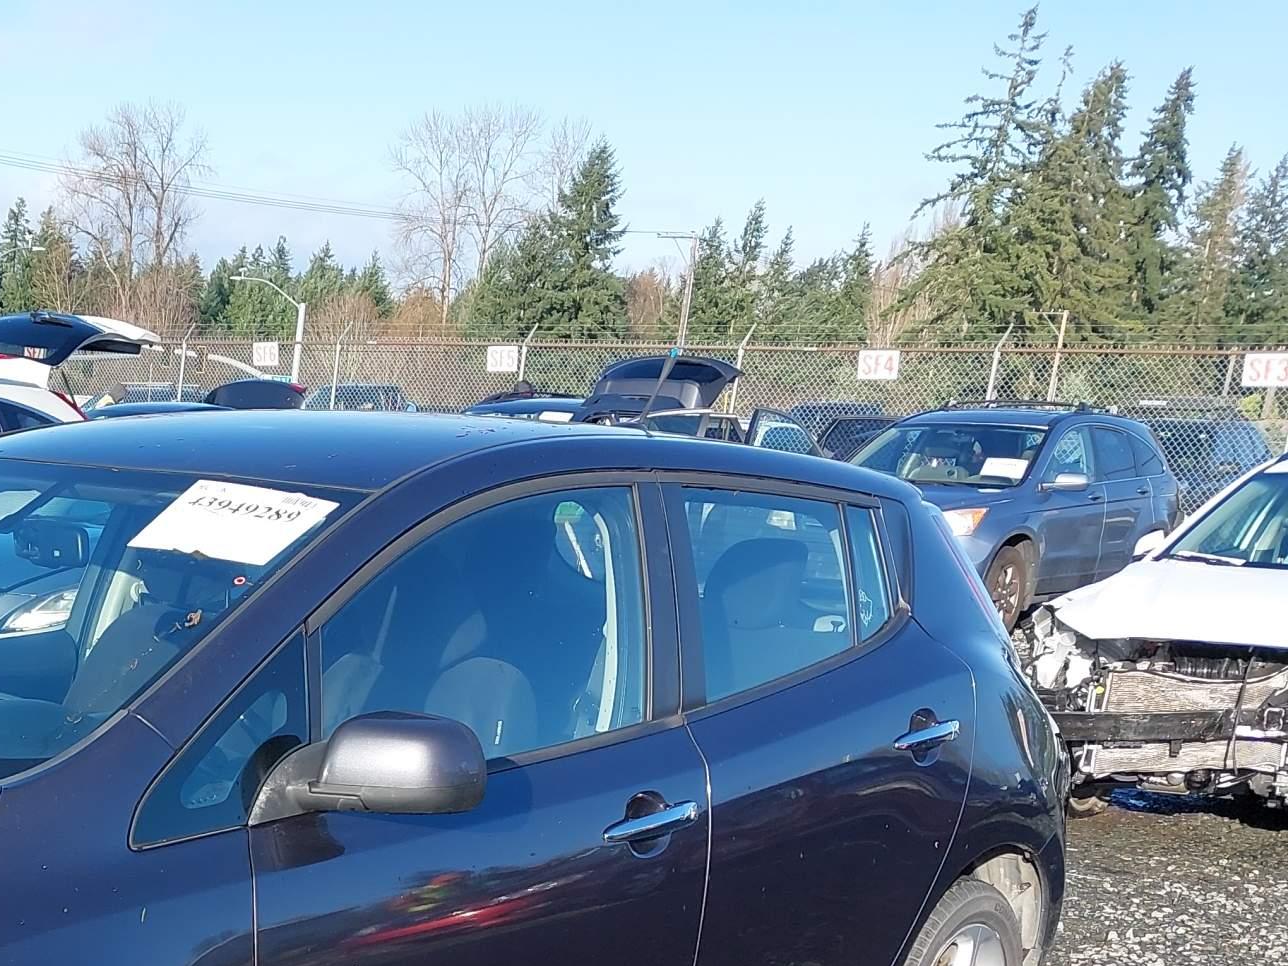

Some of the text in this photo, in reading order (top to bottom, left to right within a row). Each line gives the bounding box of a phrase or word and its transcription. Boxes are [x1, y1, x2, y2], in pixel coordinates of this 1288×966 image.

[256, 344, 276, 362] SF6
[490, 349, 515, 368] SF5
[862, 354, 894, 376] SF4
[1249, 358, 1288, 382] SF3
[188, 495, 301, 522] 43949289
